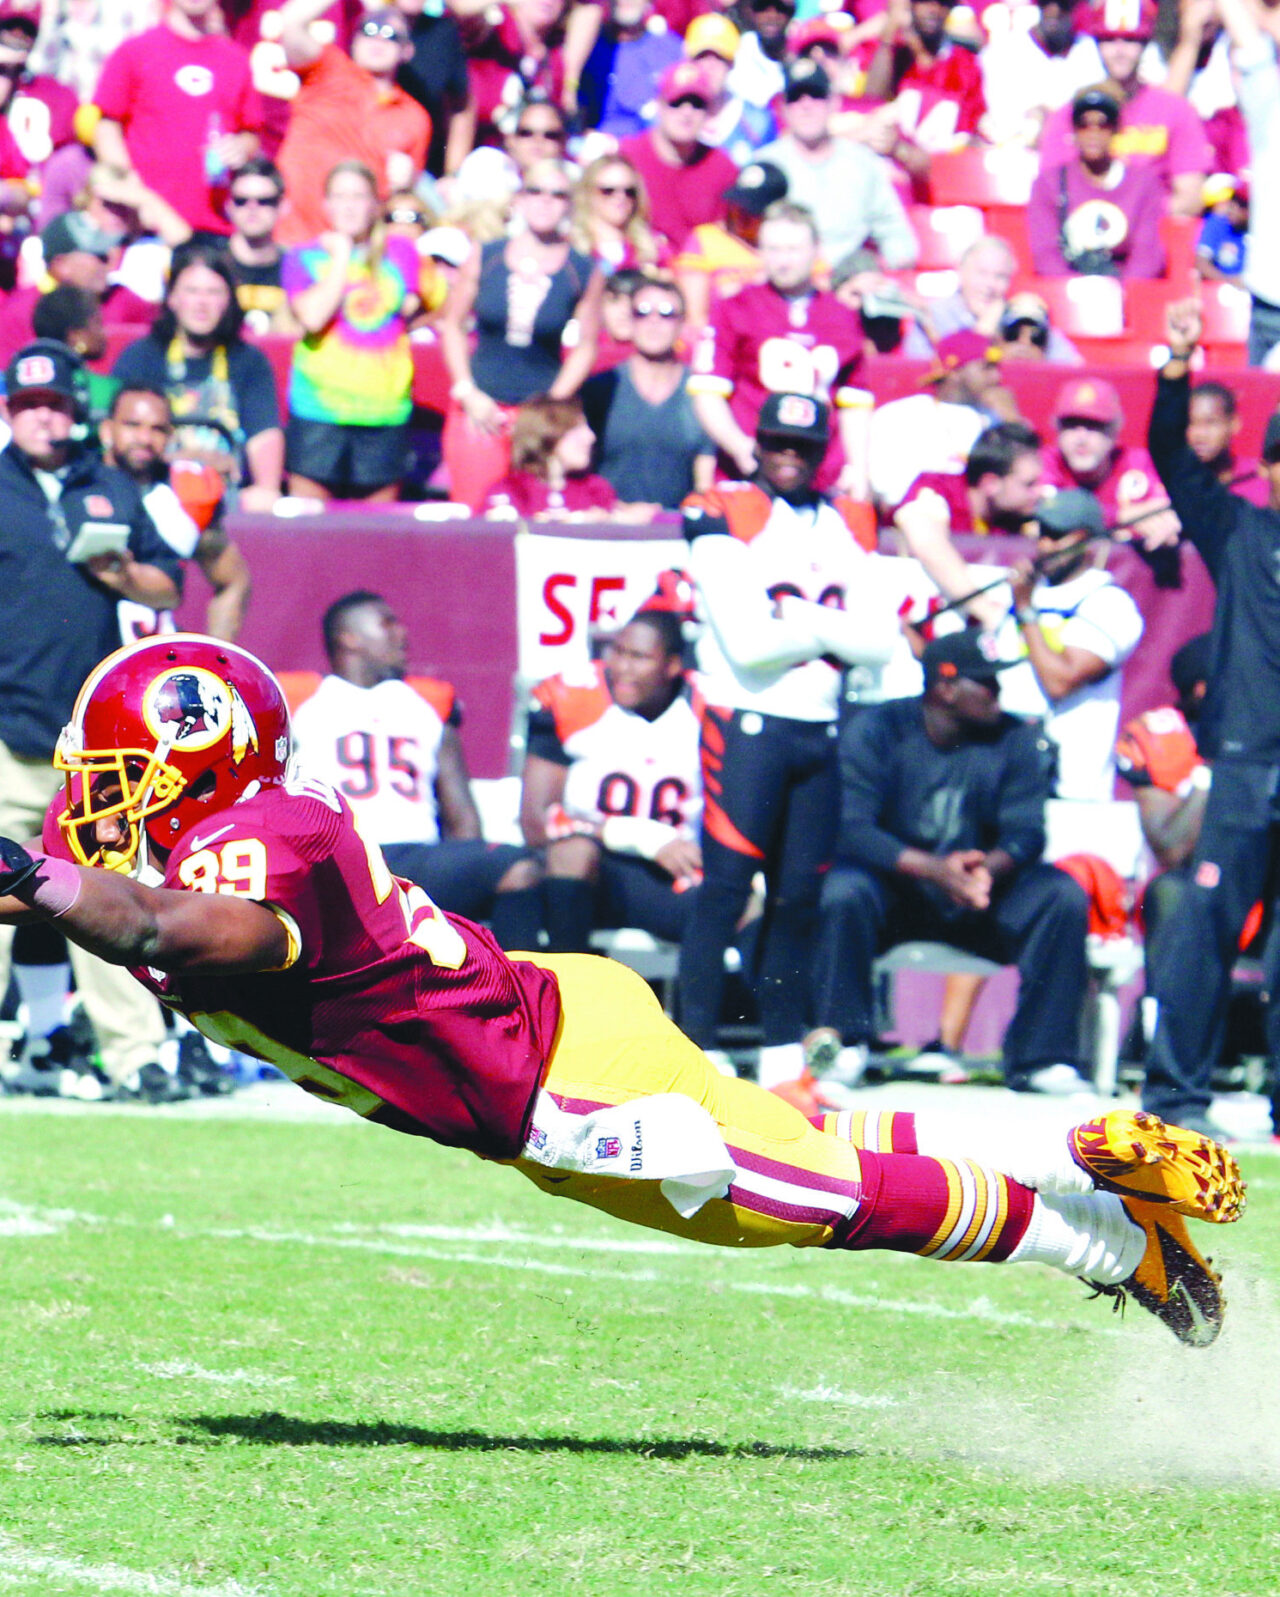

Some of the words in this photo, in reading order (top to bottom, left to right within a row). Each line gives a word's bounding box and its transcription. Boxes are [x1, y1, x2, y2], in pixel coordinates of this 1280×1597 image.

[336, 731, 421, 804] 95
[178, 838, 267, 902] 39
[630, 1120, 643, 1172] Wilson
